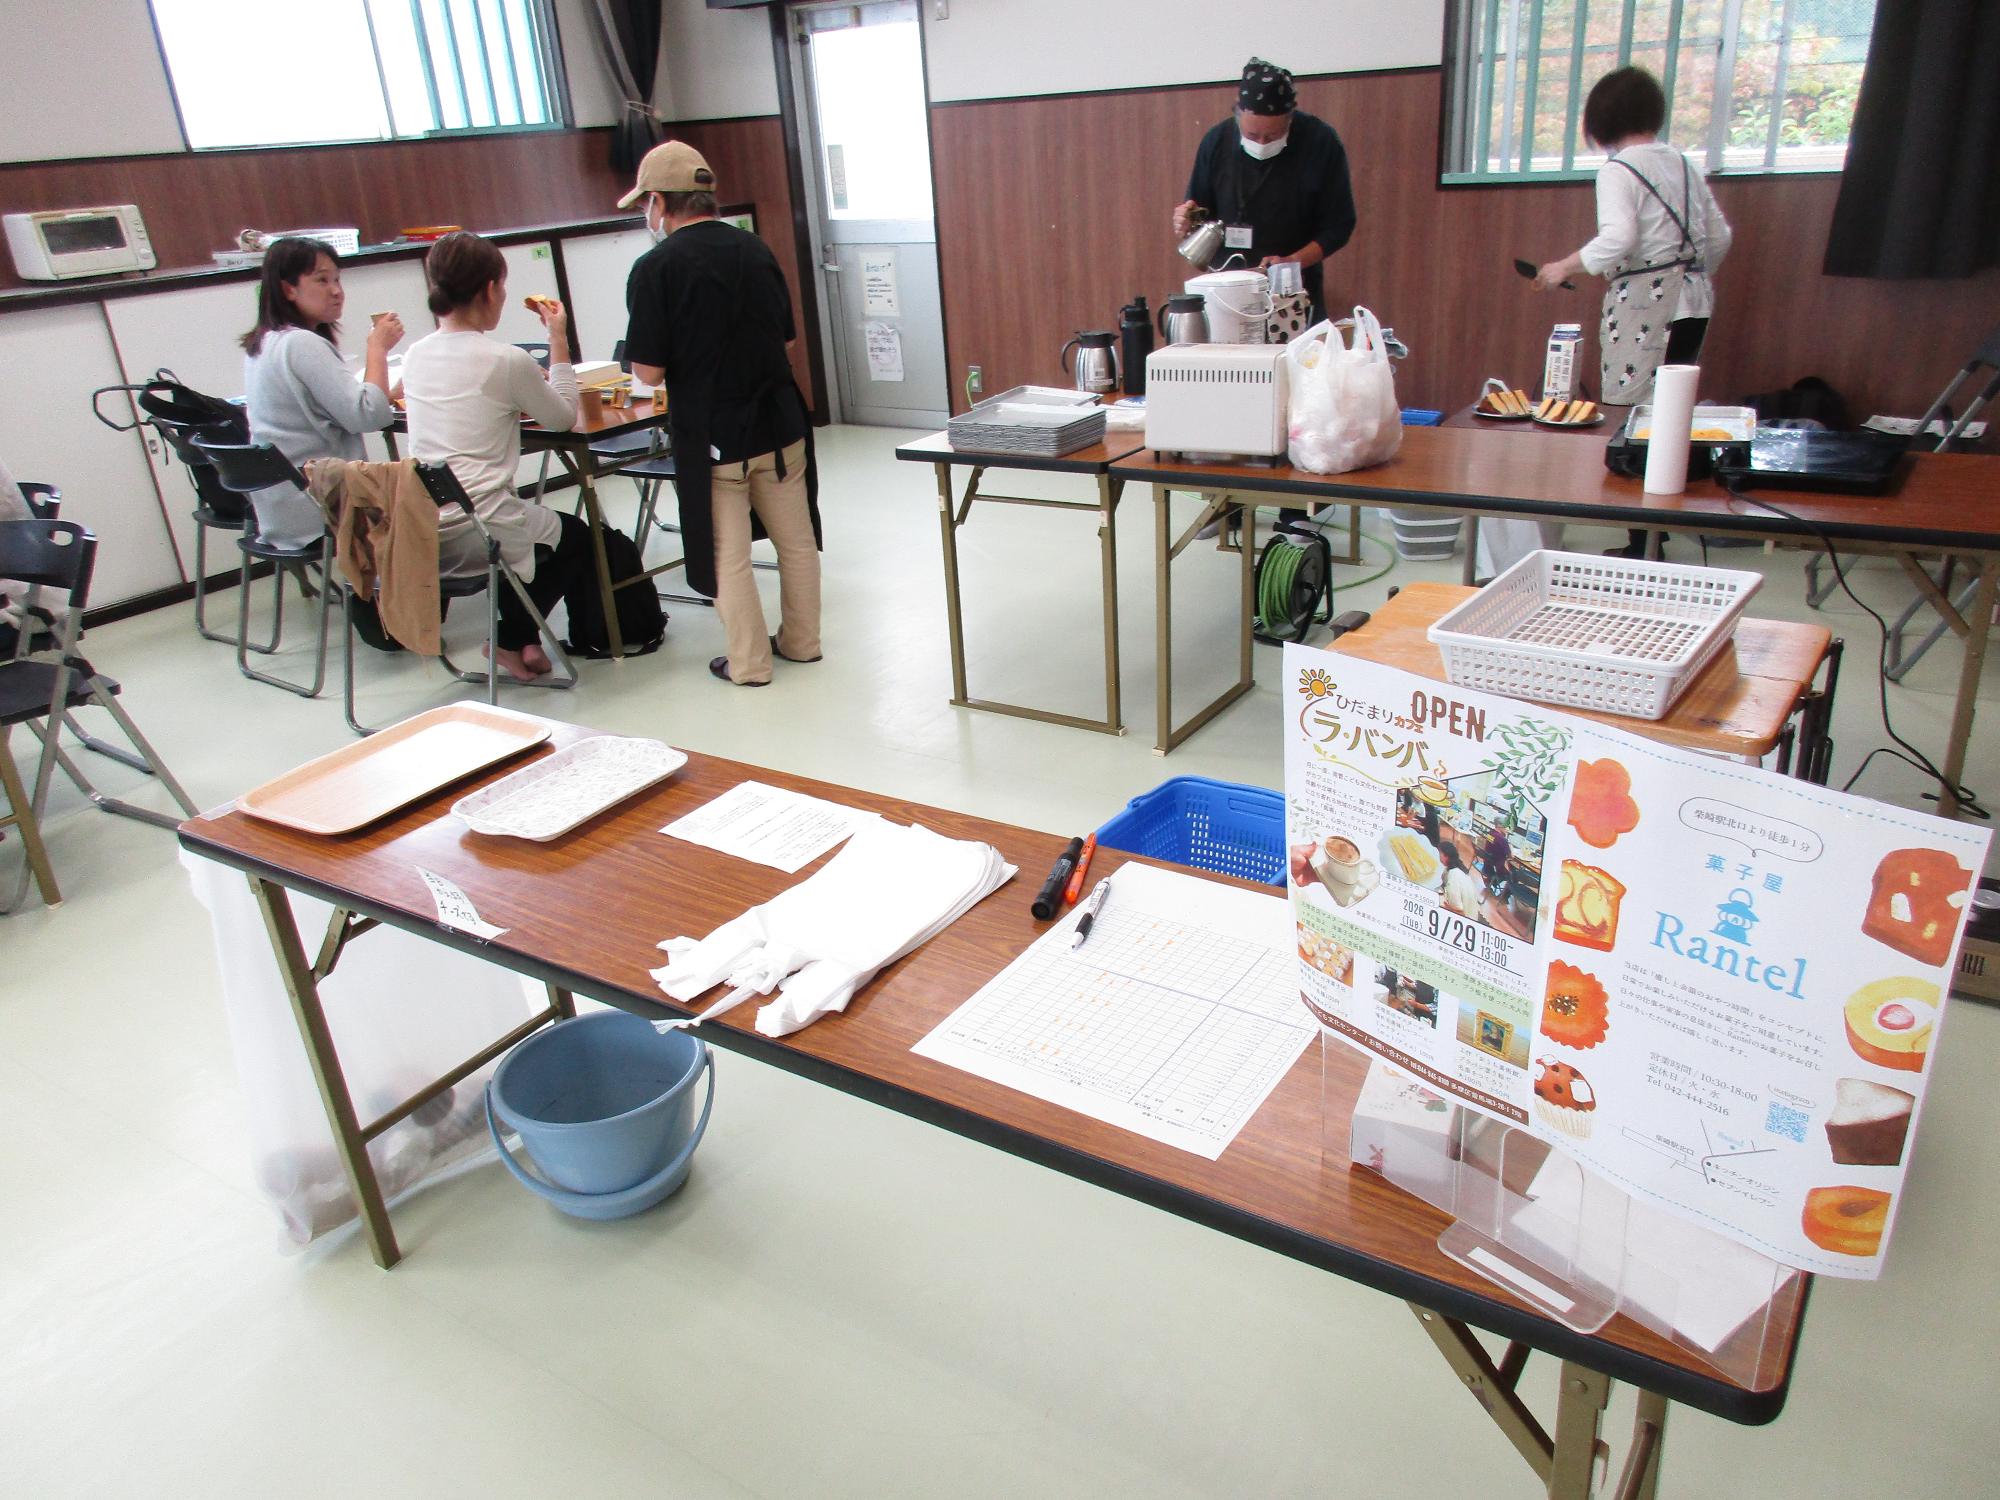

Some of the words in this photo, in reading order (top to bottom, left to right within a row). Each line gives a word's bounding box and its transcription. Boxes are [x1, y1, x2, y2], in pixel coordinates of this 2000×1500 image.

[1336, 694, 1394, 724] ひだまり
[1394, 715, 1424, 735] カフェ
[1411, 691, 1486, 743] OPEN
[1313, 709, 1429, 771] ラ・バンバ
[1705, 853, 1784, 894] 菓子屋
[1403, 899, 1424, 917] 2026
[1428, 909, 1476, 953] 9/29
[1481, 945, 1507, 967] 13:00
[1650, 910, 1808, 999] Rantel
[1649, 1063, 1678, 1081] 定休日
[1650, 1051, 1692, 1075] 営業時間
[1701, 1072, 1758, 1102] 10:30-18:00
[1664, 1082, 1729, 1116] 042-444-2516
